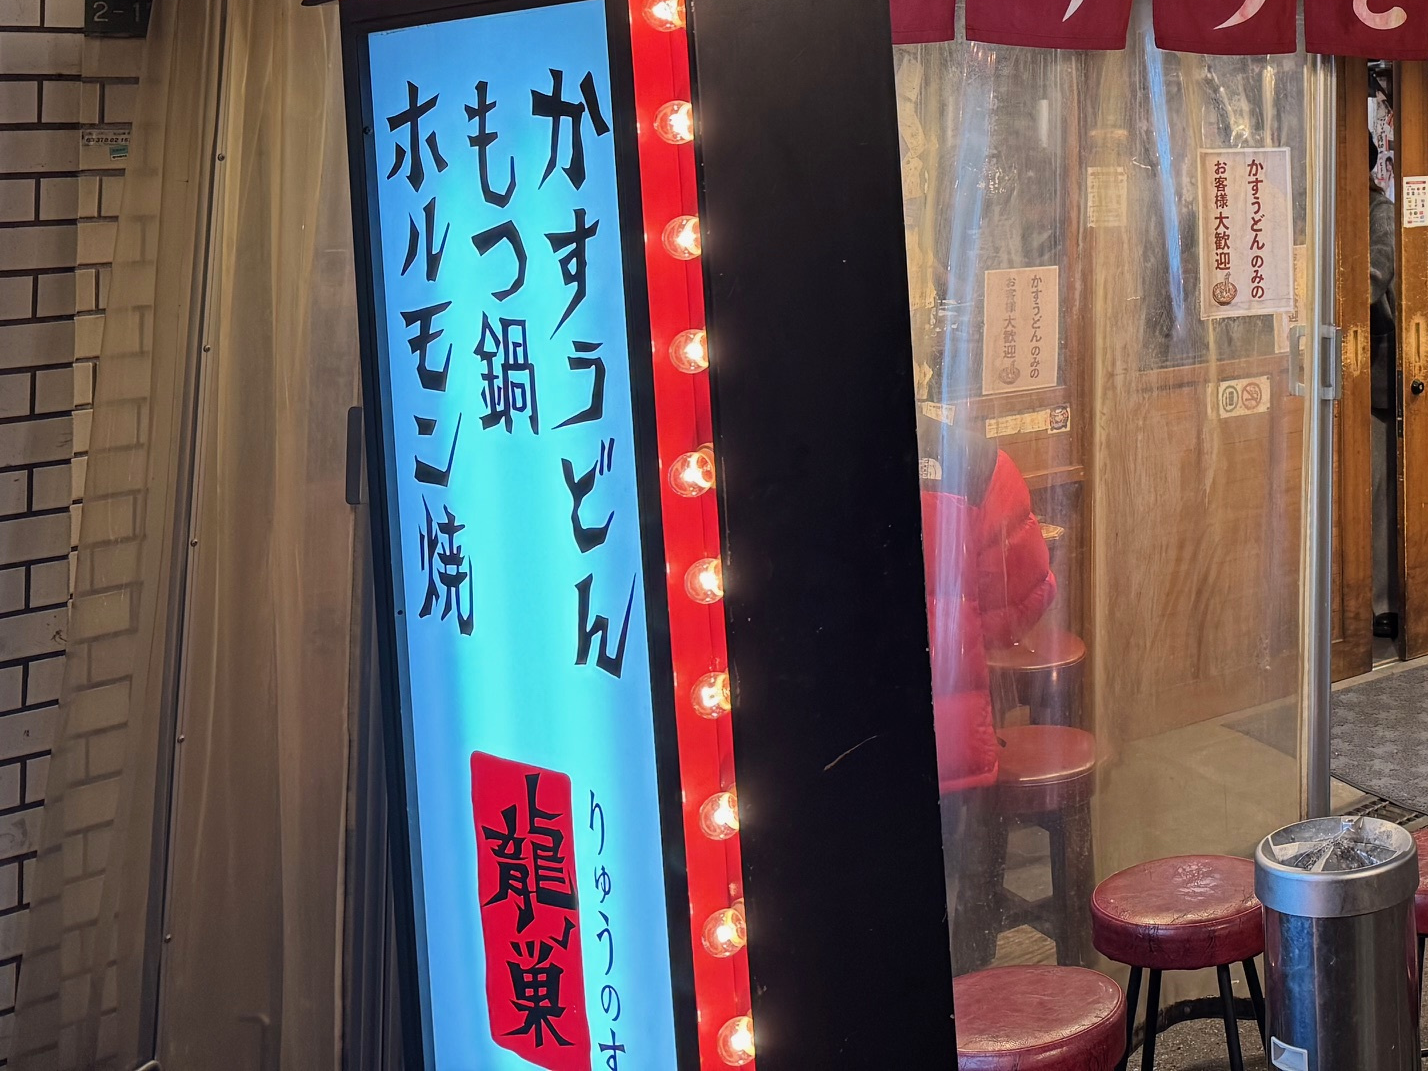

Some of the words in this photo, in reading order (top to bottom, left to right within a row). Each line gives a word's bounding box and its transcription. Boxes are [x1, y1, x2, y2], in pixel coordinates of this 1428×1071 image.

[386, 81, 474, 636] ホルモン焼
[465, 80, 540, 435] もつ鍋
[530, 68, 636, 678] かすうどん
